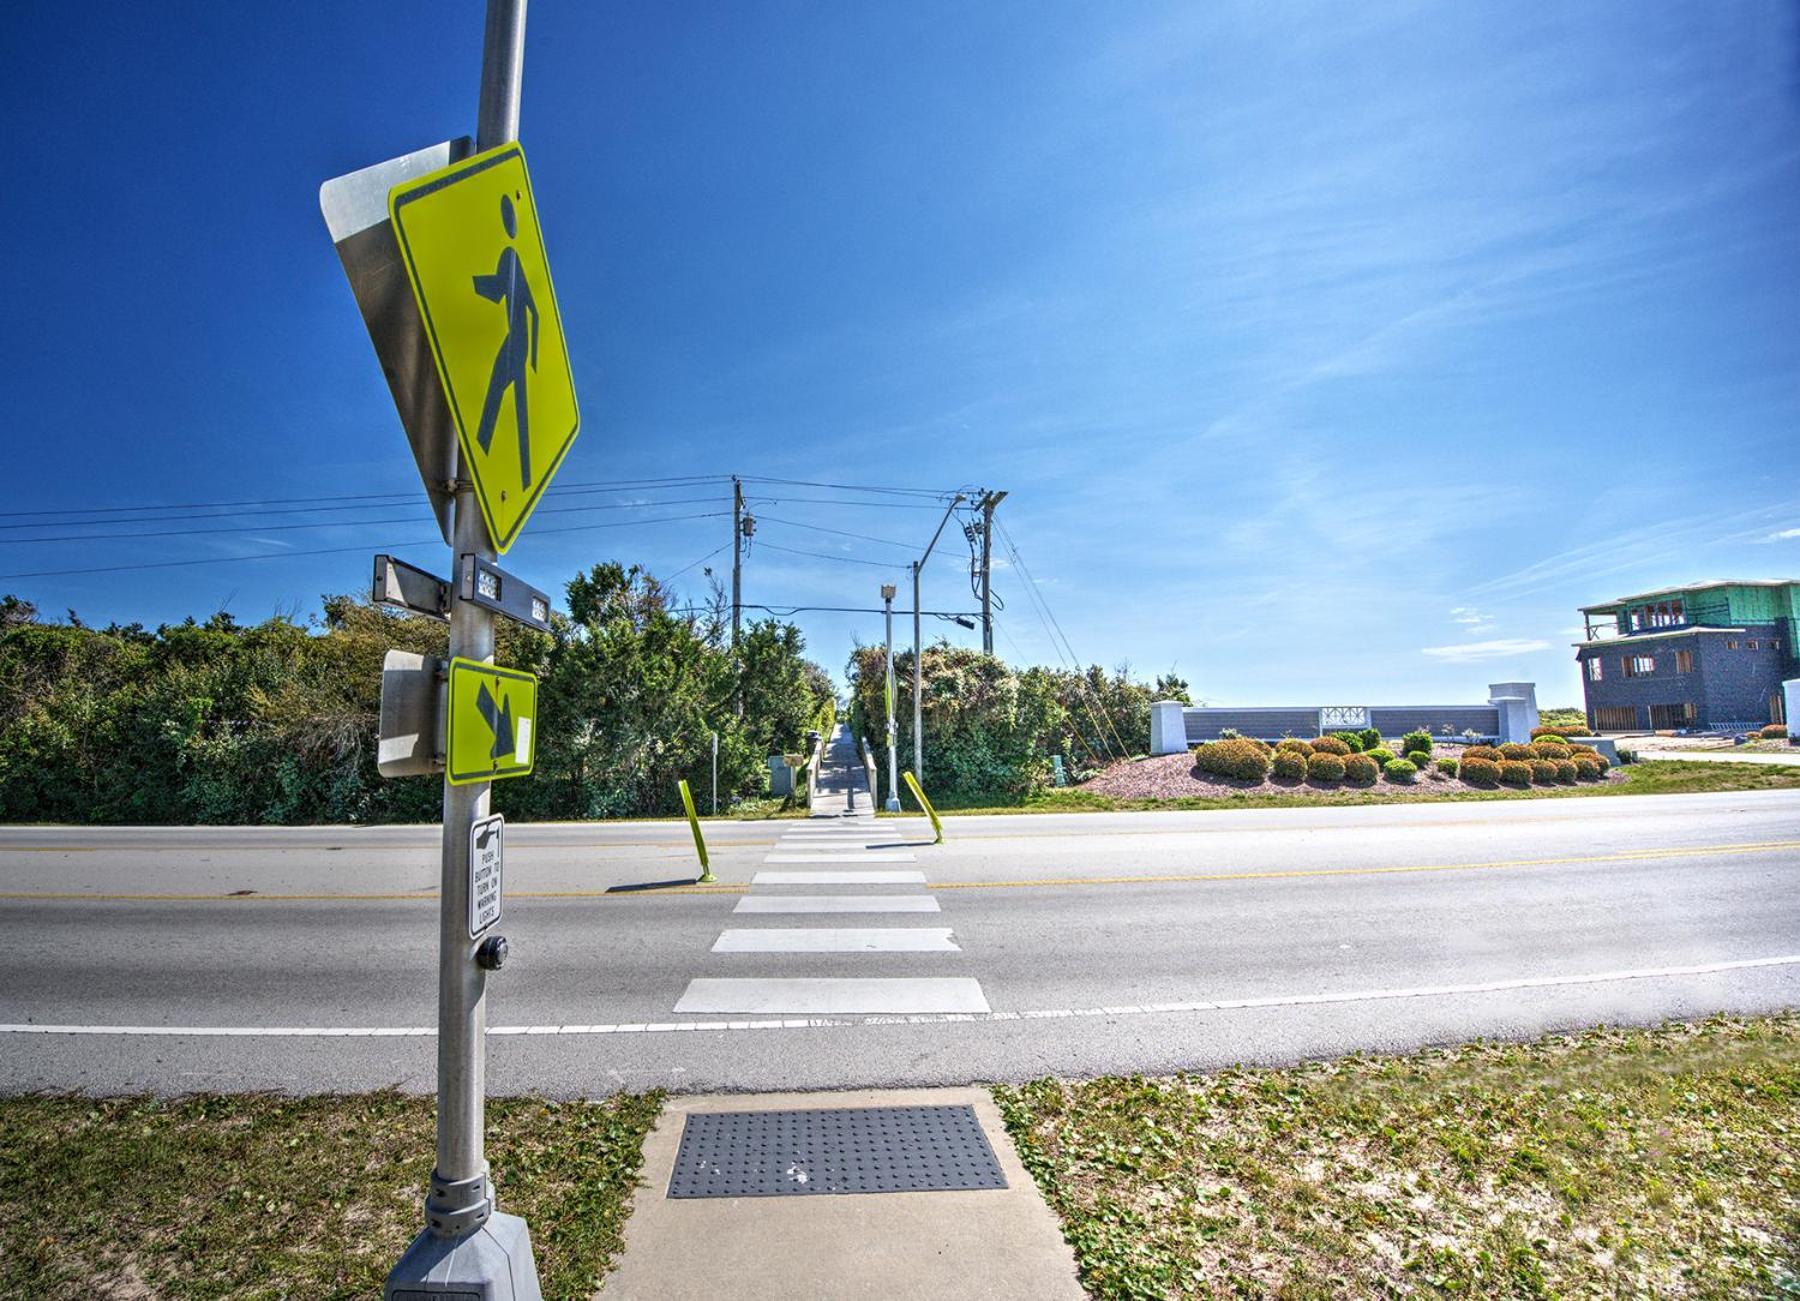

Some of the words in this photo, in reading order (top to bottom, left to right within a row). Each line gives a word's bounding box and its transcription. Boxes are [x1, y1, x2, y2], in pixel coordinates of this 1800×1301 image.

[482, 851, 494, 864] PUSH
[475, 866, 492, 883] BUTTON
[494, 861, 499, 872] TO
[478, 882, 489, 895] TURN
[491, 877, 497, 889] ON
[478, 890, 497, 910] WARNING
[480, 906, 494, 924] LIGHTS
